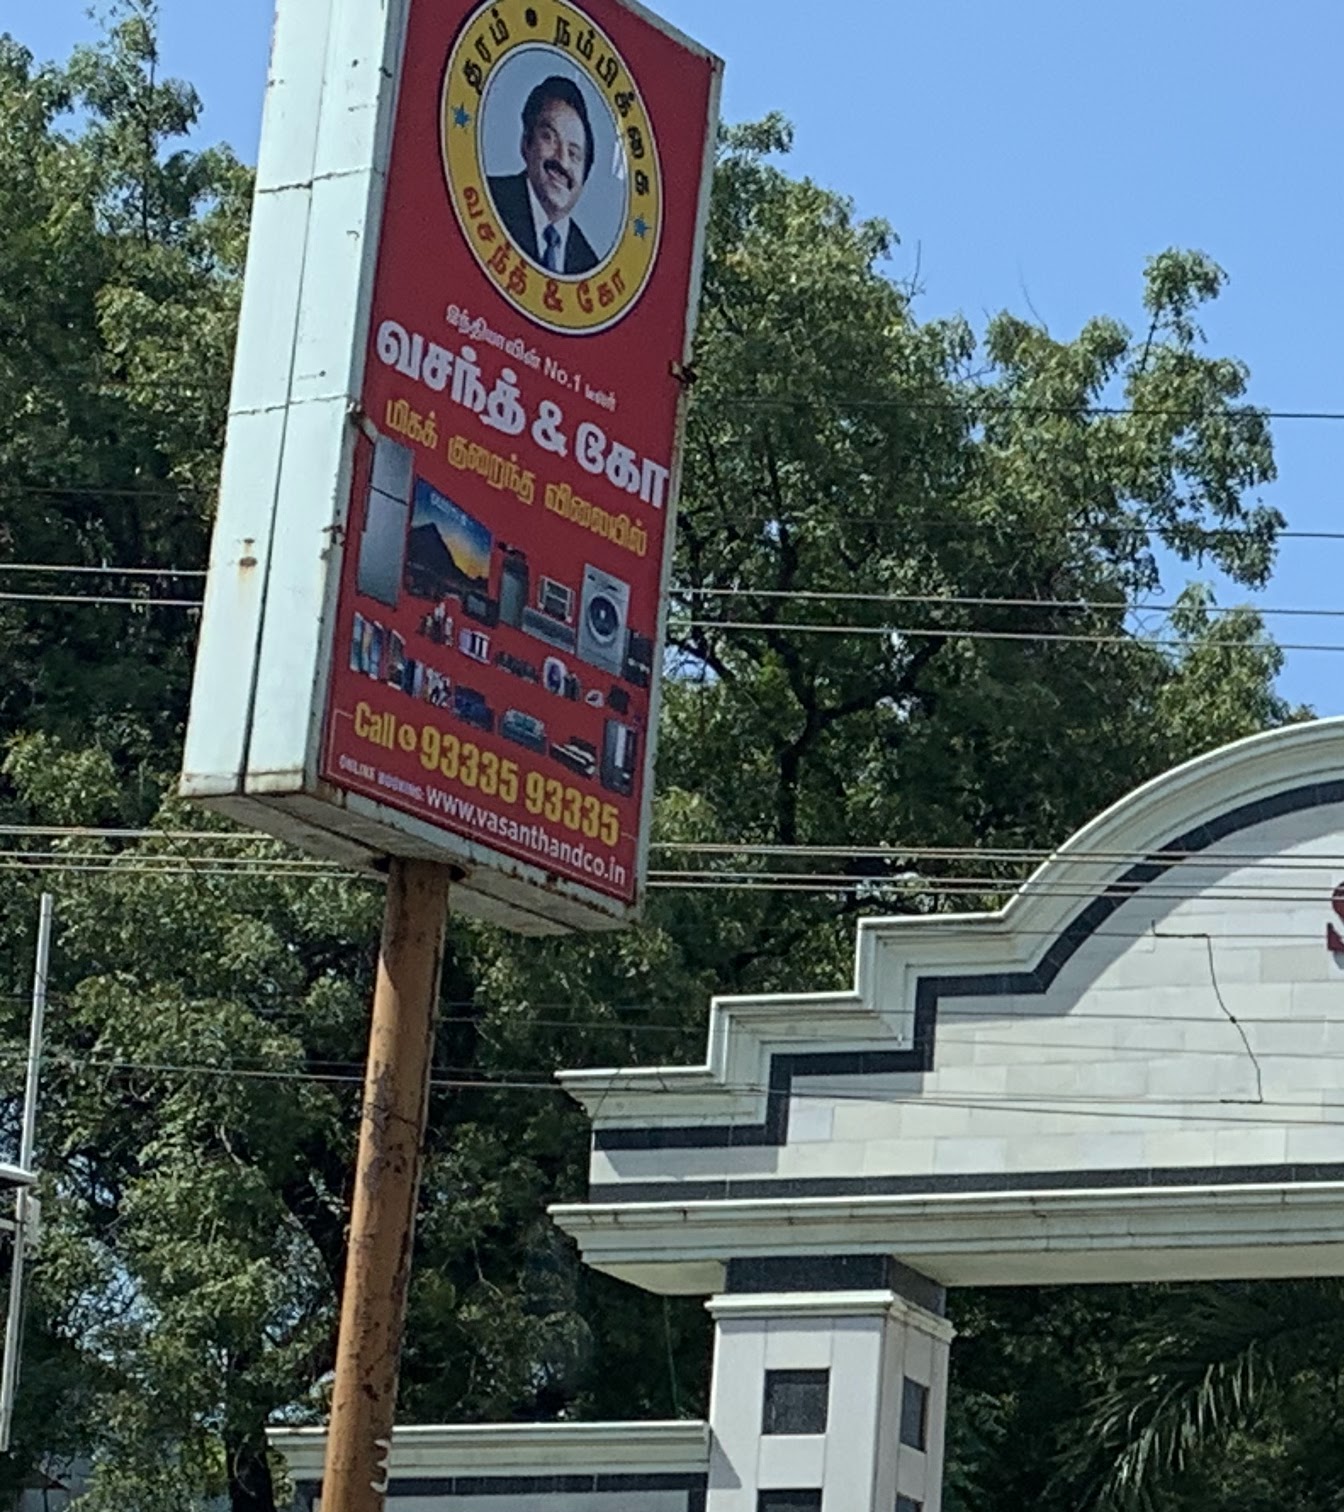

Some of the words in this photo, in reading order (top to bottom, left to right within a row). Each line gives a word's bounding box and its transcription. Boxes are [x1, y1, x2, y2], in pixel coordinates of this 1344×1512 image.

[463, 186, 528, 296] வசந்த்
[543, 279, 564, 313] &
[576, 268, 626, 314] கோ
[376, 320, 526, 435] வசந்த்
[531, 400, 568, 458] &
[575, 422, 670, 509] கோ
[544, 356, 582, 393] No.1
[447, 435, 536, 505] குறைந்த
[544, 482, 648, 557] விலையில்
[354, 701, 397, 750] Call
[419, 725, 520, 804] 93335
[524, 771, 620, 847] 93335
